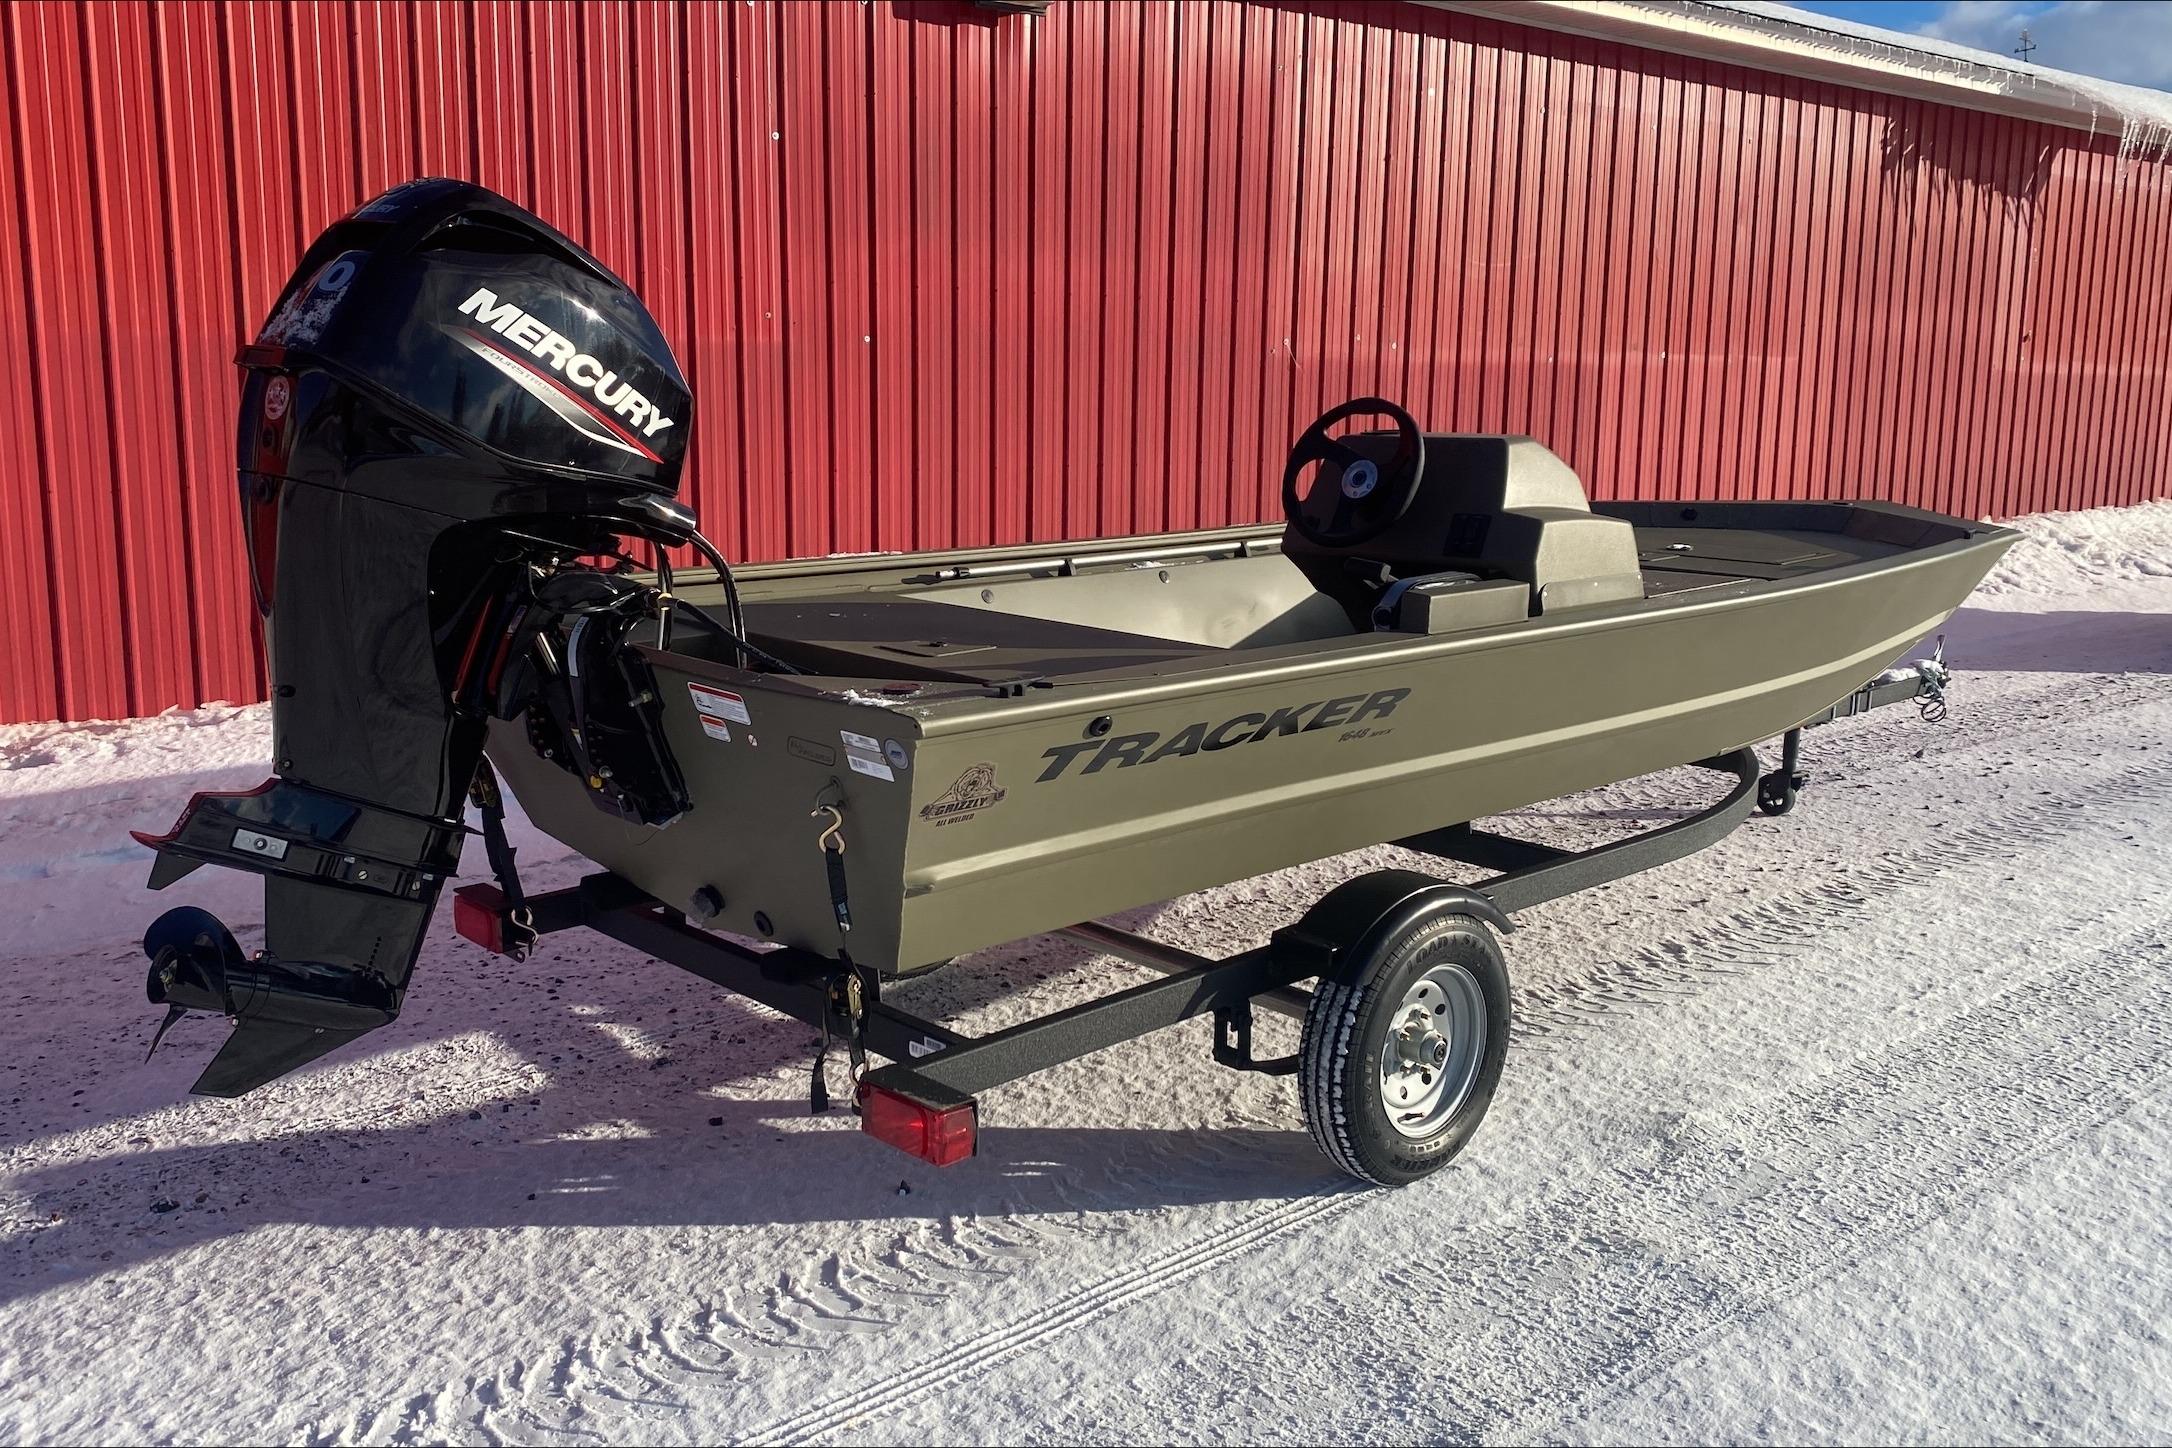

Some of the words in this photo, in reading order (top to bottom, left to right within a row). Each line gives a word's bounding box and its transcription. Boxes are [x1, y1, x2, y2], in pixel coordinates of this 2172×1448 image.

[457, 287, 675, 438] MERCURY
[480, 346, 564, 400] FOURSTROKE
[1034, 687, 1412, 784] TRACKER
[934, 796, 989, 817] GRIZZLY
[935, 817, 948, 828] ALL
[947, 813, 976, 826] WELDED
